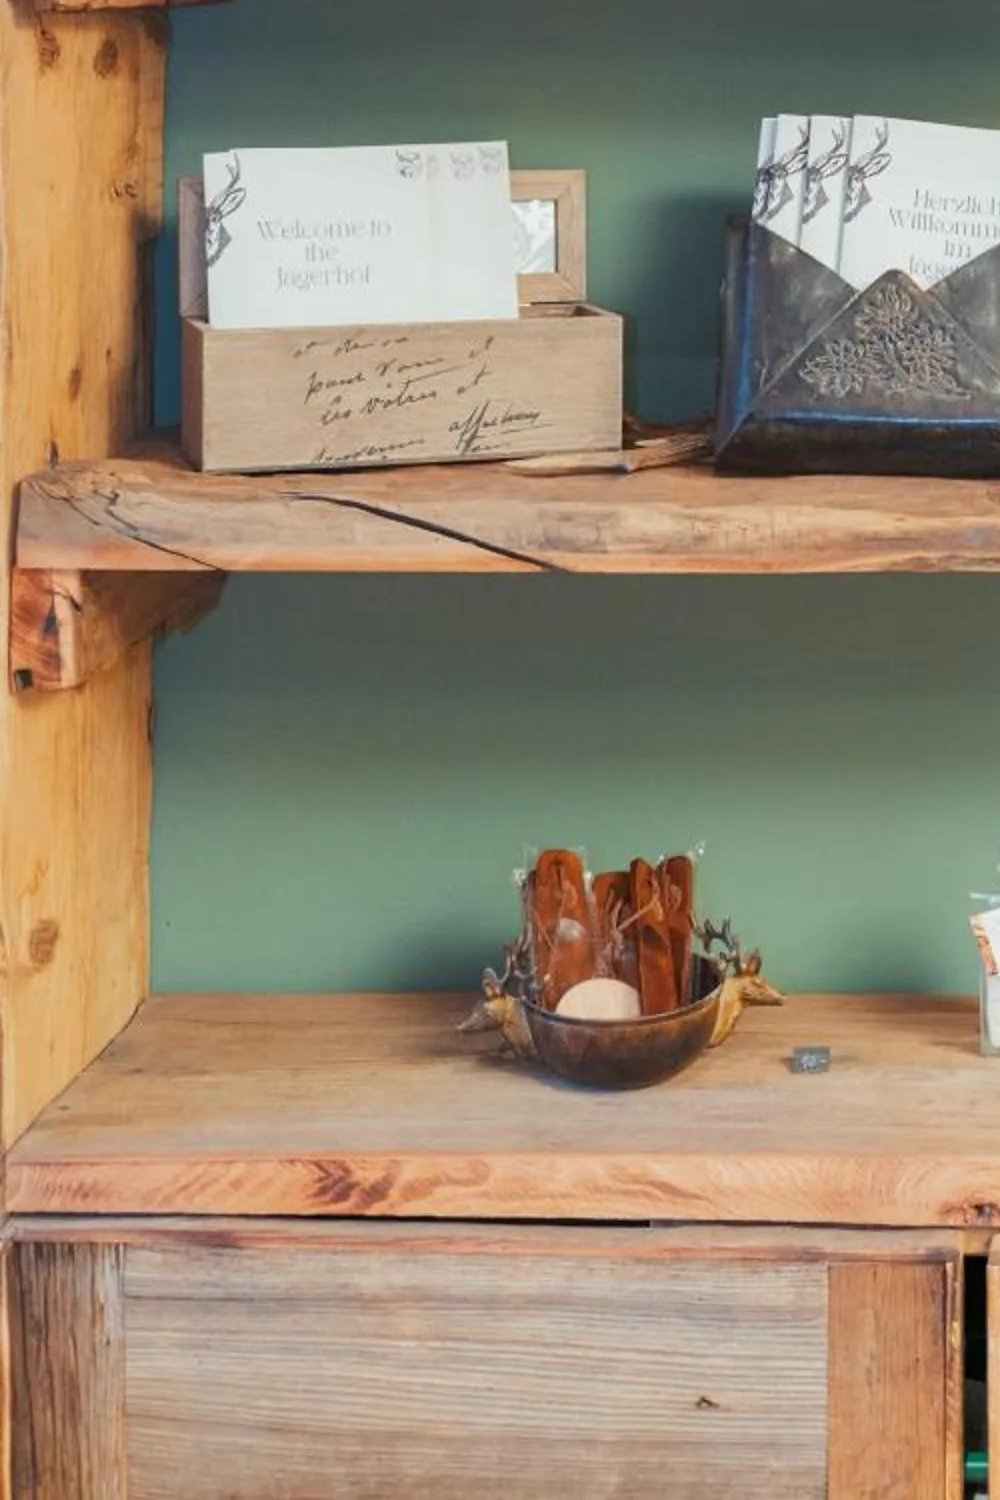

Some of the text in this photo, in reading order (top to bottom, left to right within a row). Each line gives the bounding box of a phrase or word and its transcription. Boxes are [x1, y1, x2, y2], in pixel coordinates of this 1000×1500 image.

[256, 217, 393, 241] Welcome to
[304, 242, 340, 263] the
